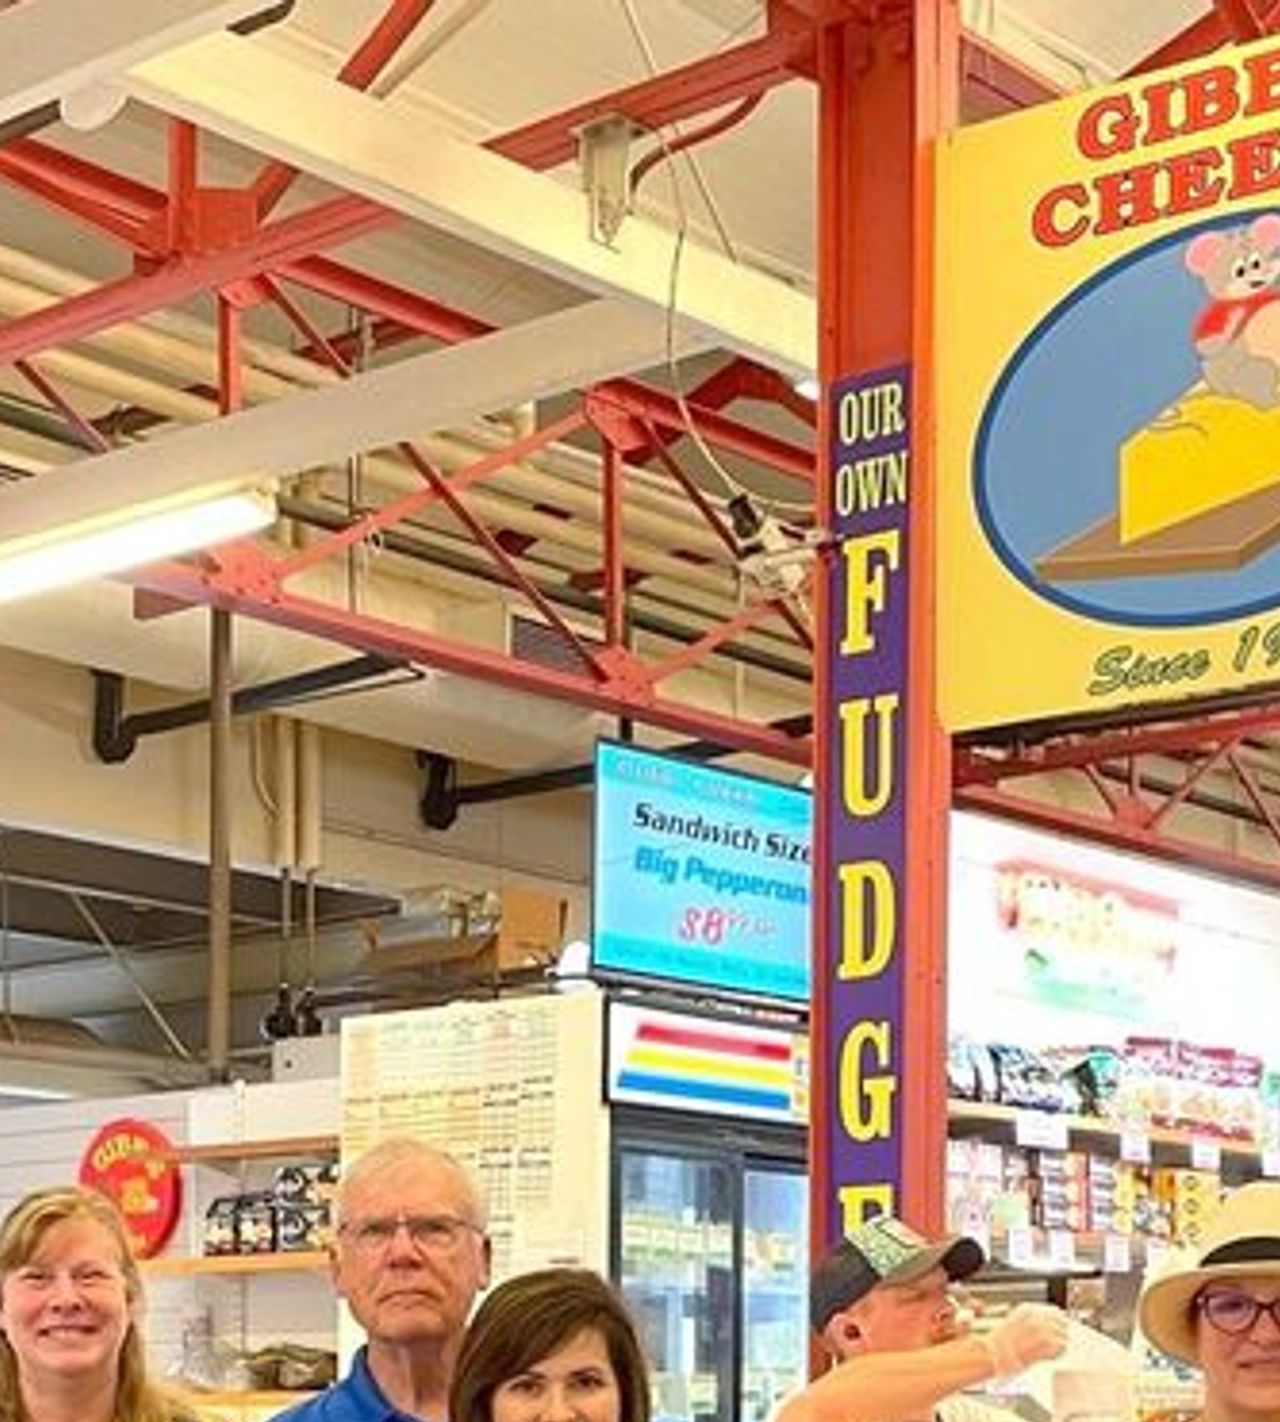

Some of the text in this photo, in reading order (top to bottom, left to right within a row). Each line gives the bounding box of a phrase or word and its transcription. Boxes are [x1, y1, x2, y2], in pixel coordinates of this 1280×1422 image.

[839, 381, 906, 447] OUR
[835, 450, 909, 518] OWN
[1087, 645, 1210, 696] Since
[633, 801, 760, 853] Sandwich
[634, 845, 809, 905] Big Pepperon
